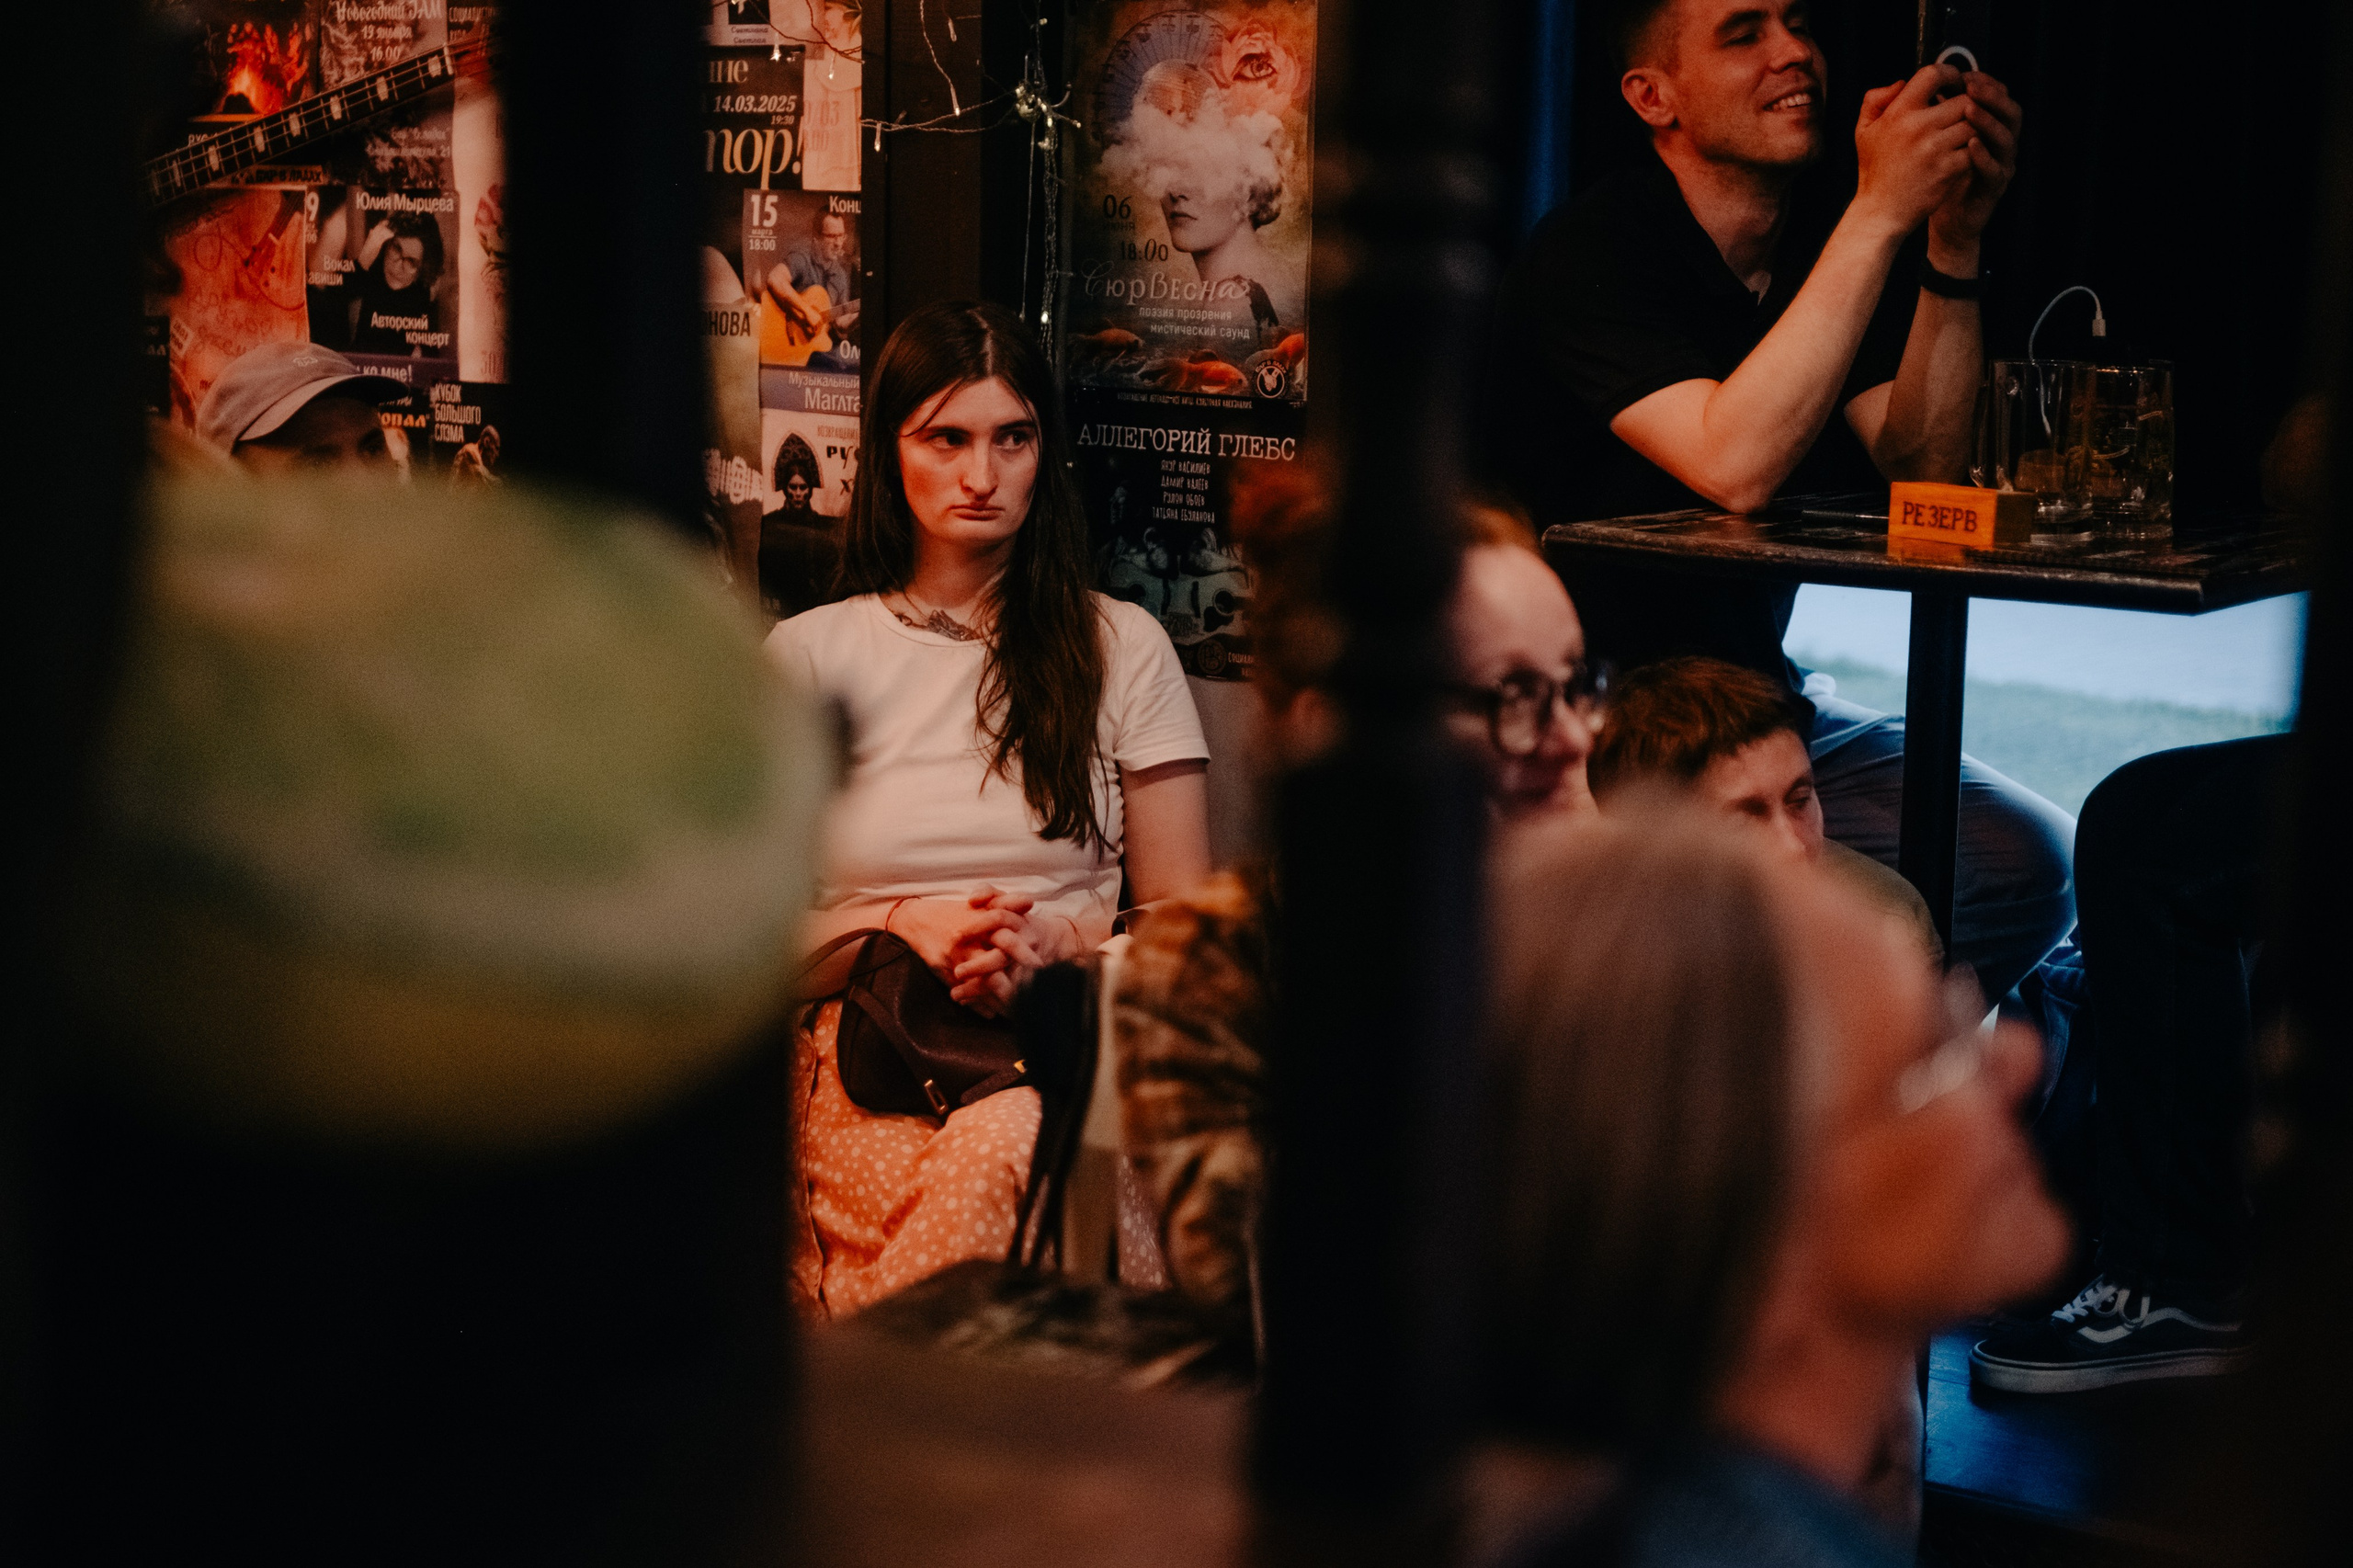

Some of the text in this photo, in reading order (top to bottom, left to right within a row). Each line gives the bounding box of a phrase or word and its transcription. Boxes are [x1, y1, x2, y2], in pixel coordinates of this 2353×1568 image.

[713, 95, 797, 113] 14.03.2025
[770, 115, 794, 126] 19:30
[356, 191, 455, 216] Юлия Мырцева
[750, 194, 779, 228] 15
[1103, 194, 1131, 220] 06
[748, 238, 777, 251] 18:00
[1120, 237, 1169, 262] 18:00
[324, 255, 356, 273] Вокал
[370, 311, 429, 332] Авторский
[1139, 306, 1233, 322] поэзия прозрения
[404, 331, 450, 349] концерт
[1150, 323, 1251, 340] мистический саунд
[789, 371, 860, 390] Музыкальный
[434, 384, 462, 403] КУБОК
[434, 403, 482, 426] БОЛЬШОГО
[434, 423, 464, 443] СЛЭМА
[1076, 422, 1296, 460] АЛЛЕГОРИЙ ГЛЕБС
[1160, 474, 1185, 489] ДАМИР
[1163, 491, 1206, 507] РУЛОН ОБОЕВ
[1152, 506, 1179, 520] ТАТЬЯНА
[1902, 501, 1978, 533] РЕЗЕРВ
